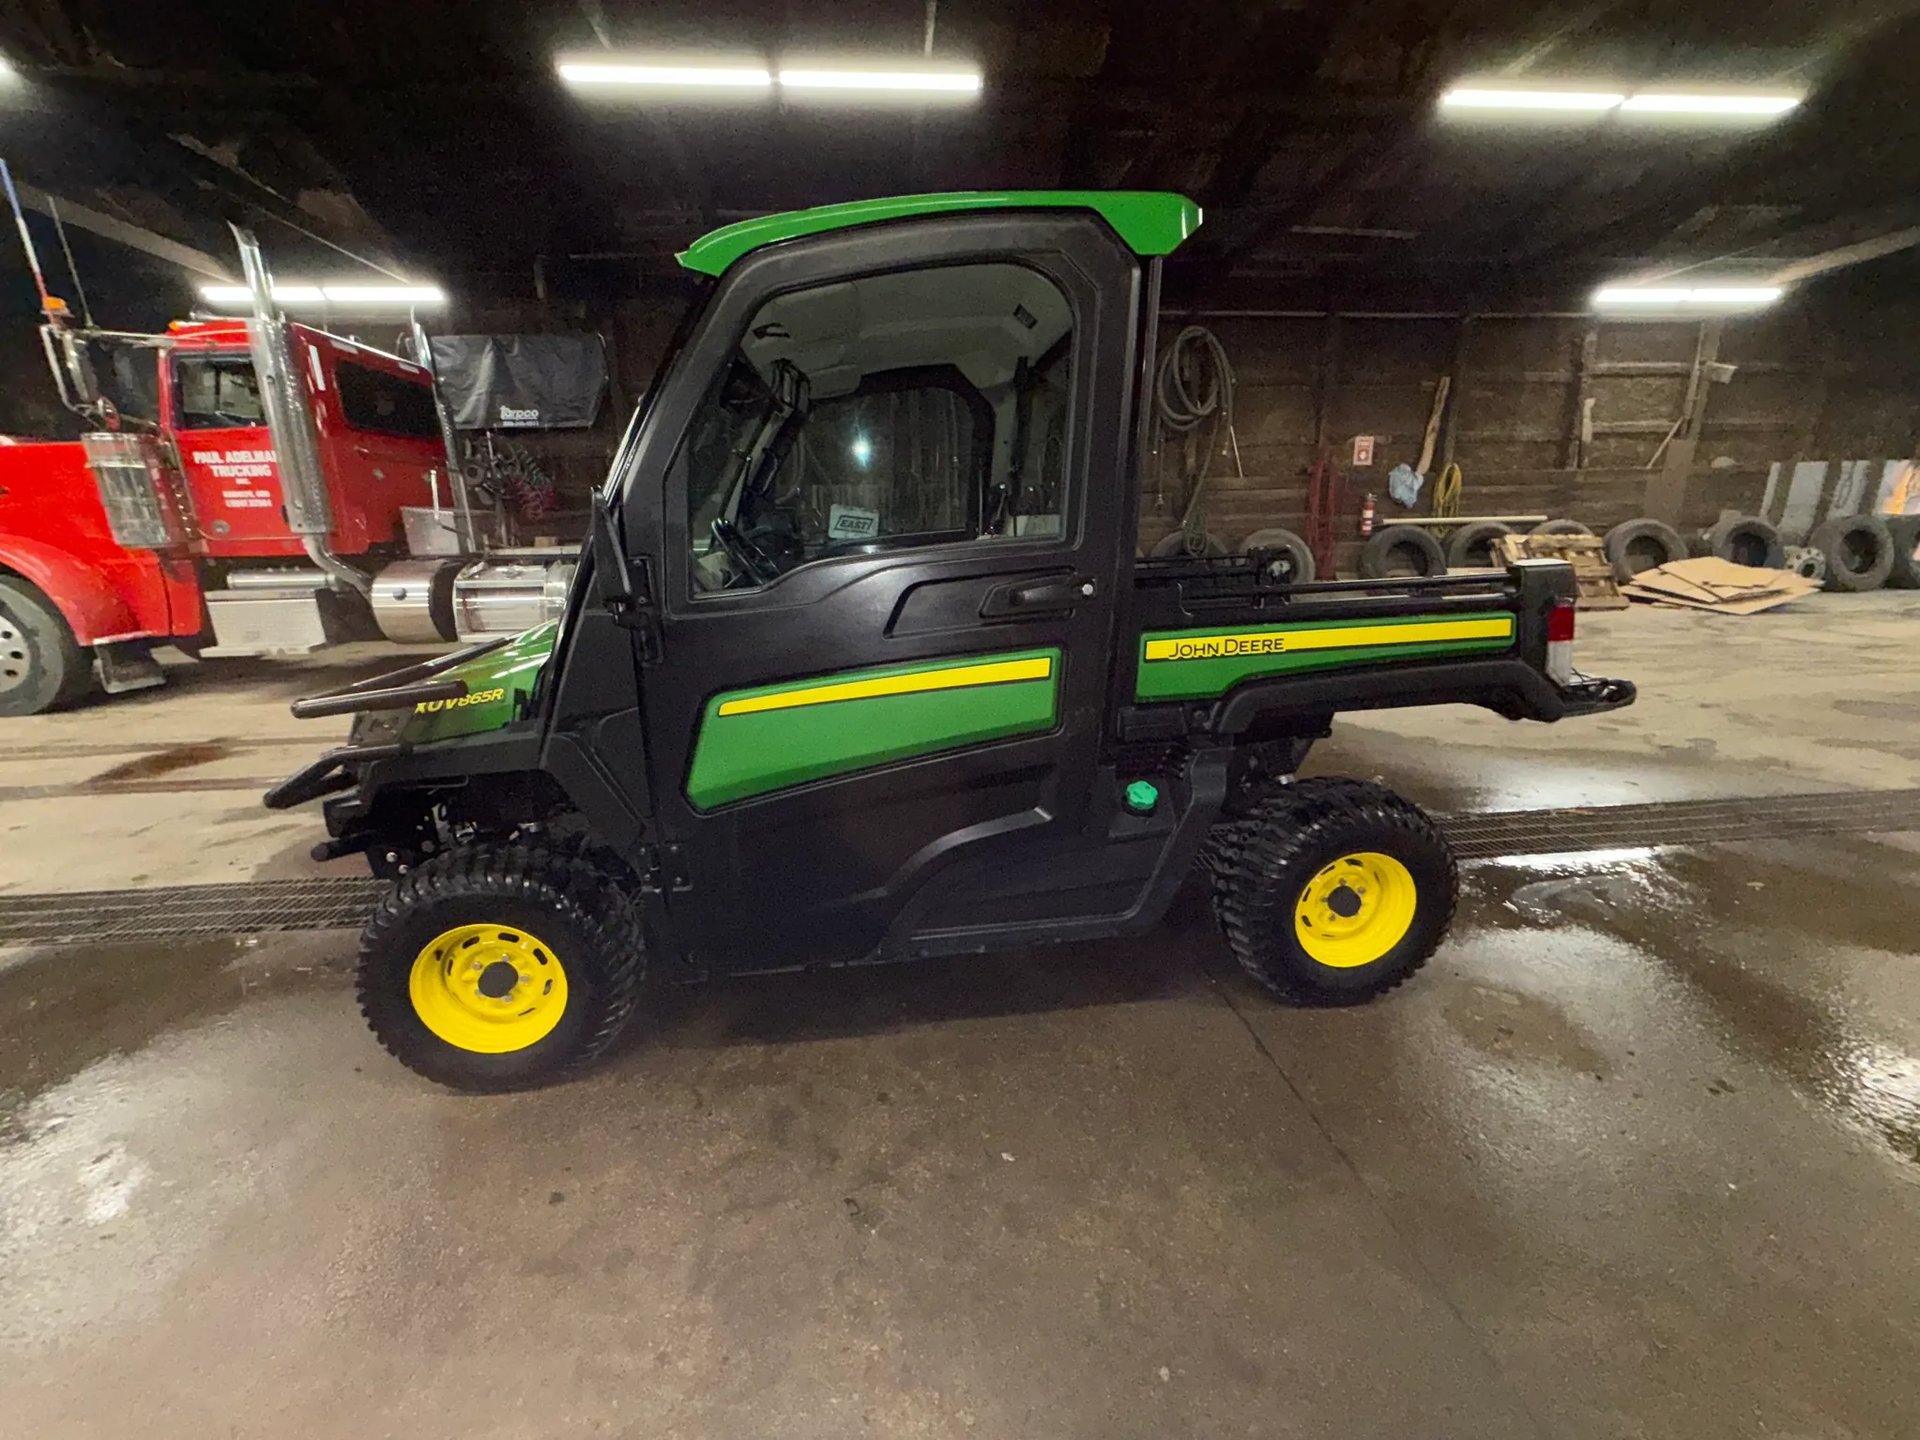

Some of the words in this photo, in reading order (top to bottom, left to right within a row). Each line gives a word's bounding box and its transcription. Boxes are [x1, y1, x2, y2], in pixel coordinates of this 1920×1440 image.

[209, 464, 272, 477] TRUCKING
[1168, 641, 1219, 658] JOHN
[1224, 638, 1285, 654] DEERE
[414, 687, 505, 714] XUV865R
